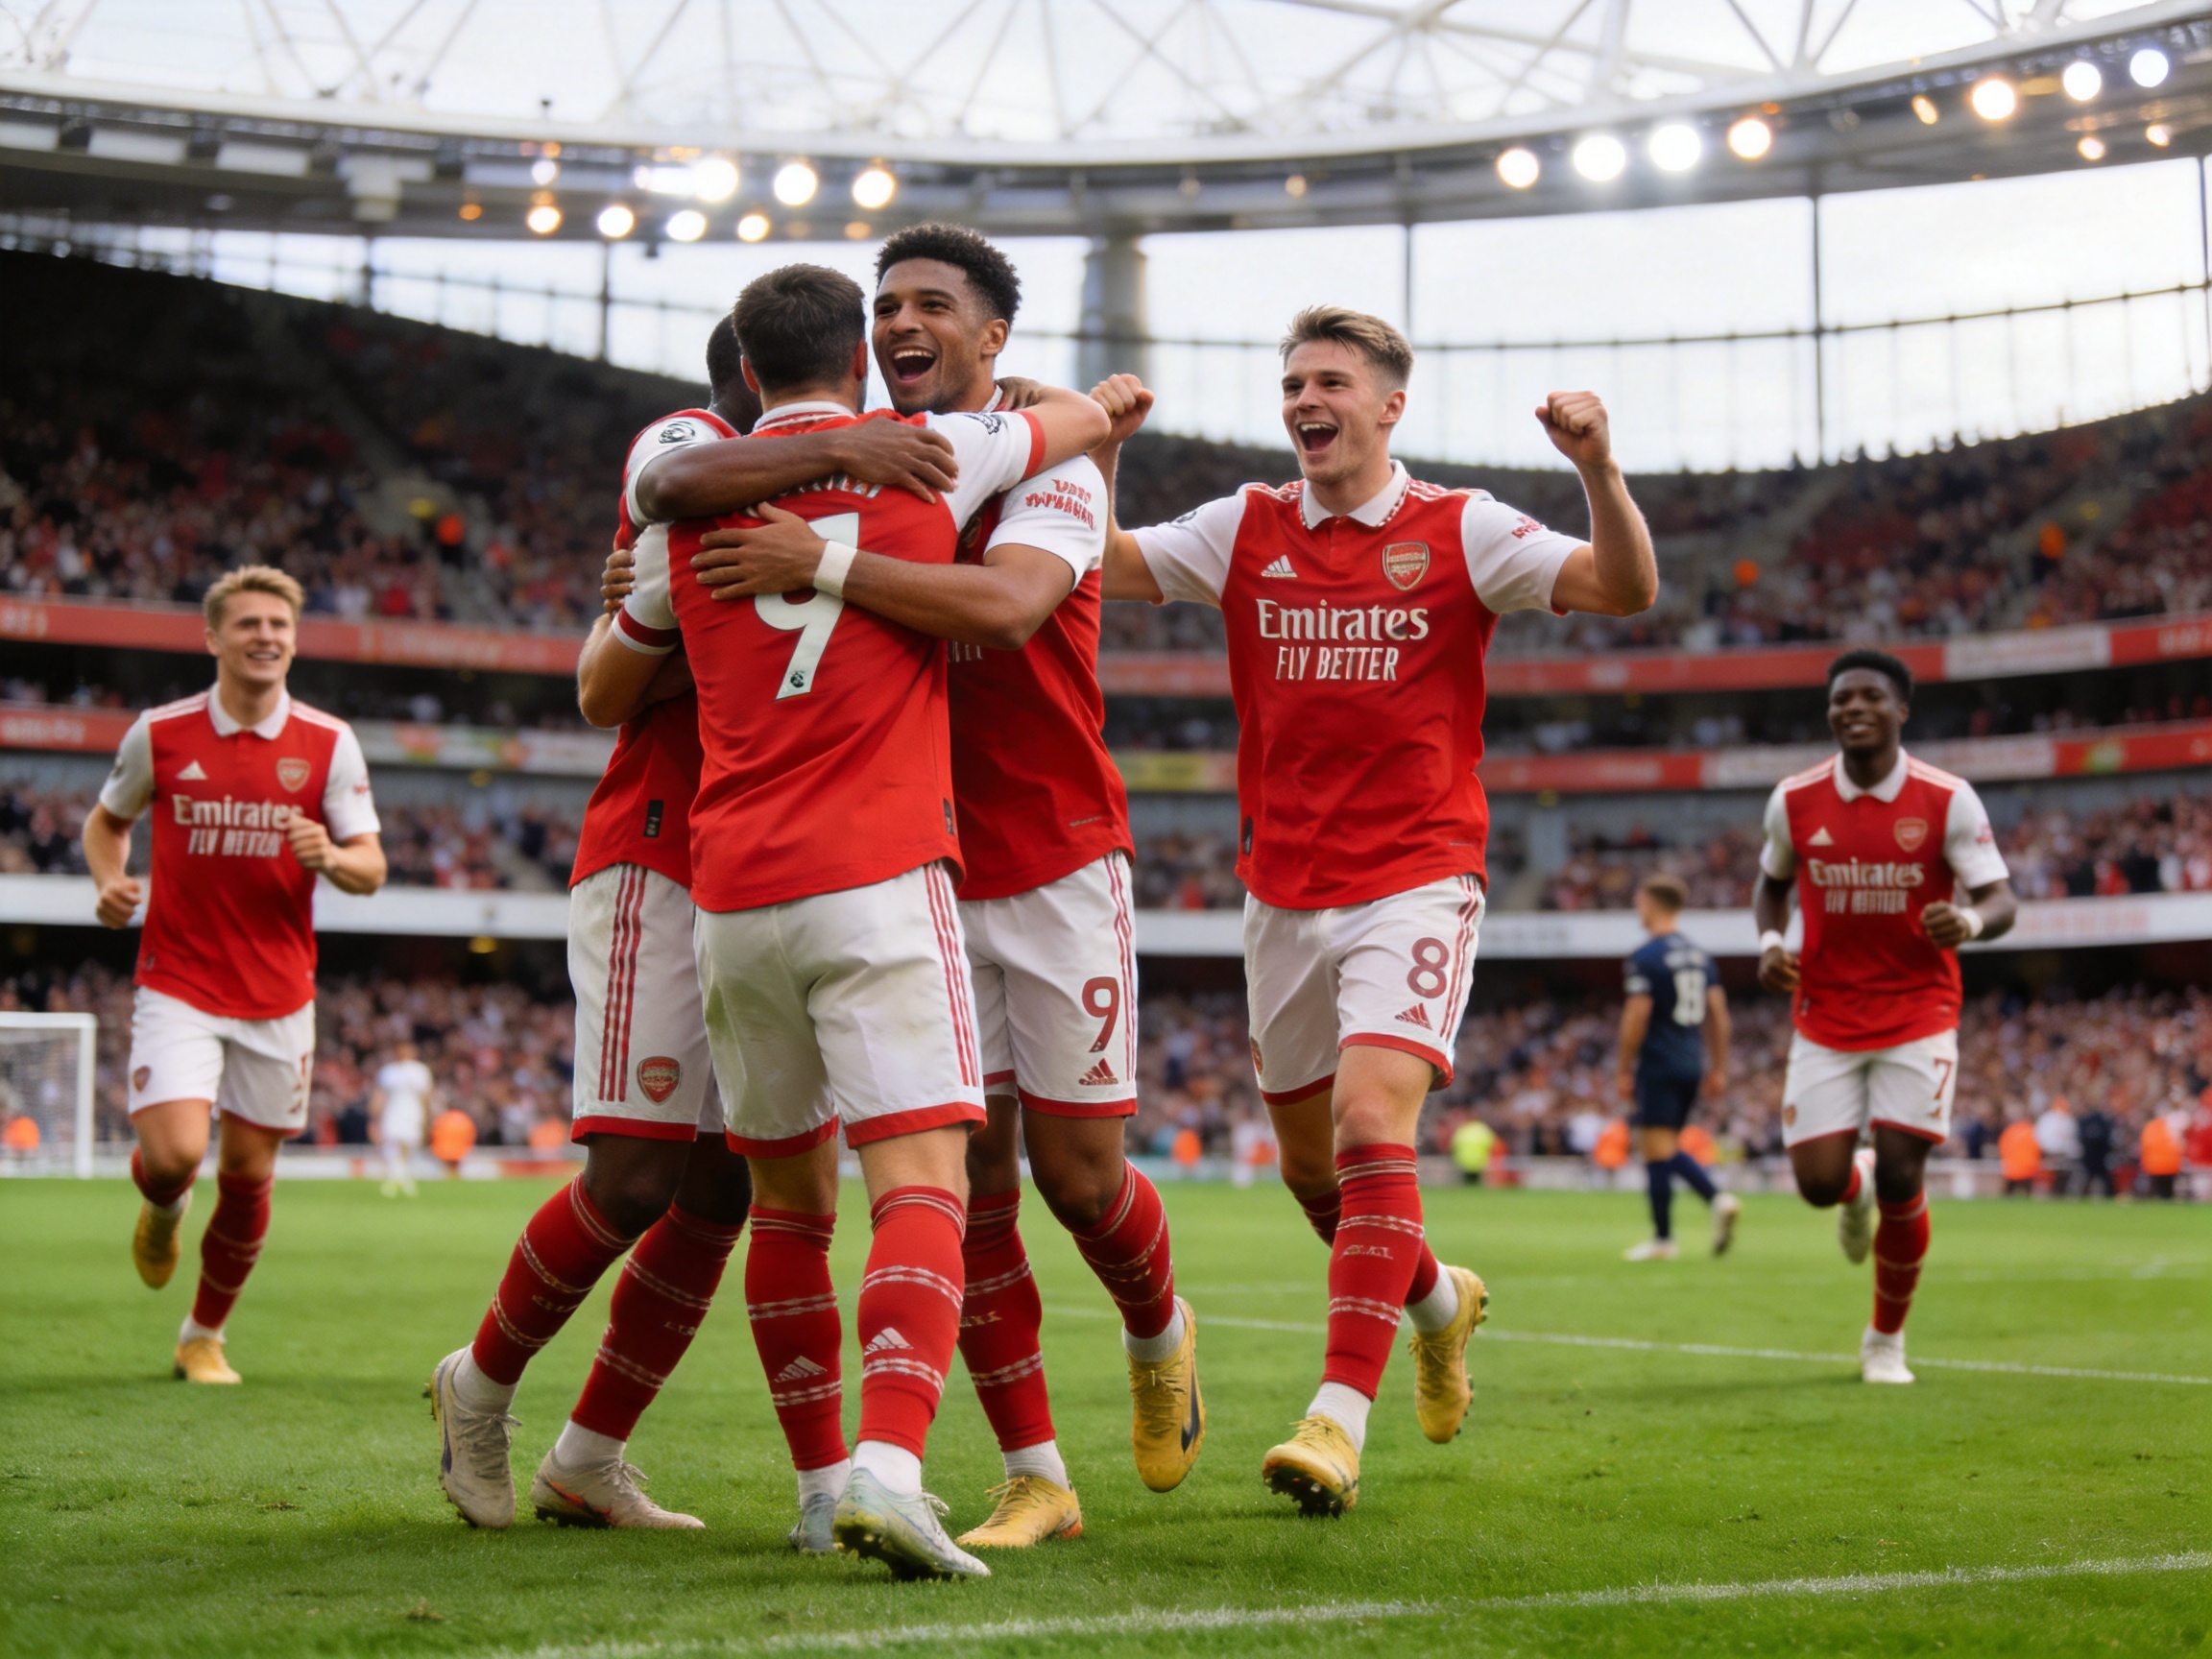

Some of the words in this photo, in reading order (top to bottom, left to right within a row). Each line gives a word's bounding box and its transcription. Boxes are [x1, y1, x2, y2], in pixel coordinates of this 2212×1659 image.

[1256, 598, 1429, 641] Emirates
[1275, 646, 1310, 681] FLY
[1315, 646, 1399, 681] BETTER
[1407, 937, 1449, 998] 8
[1082, 976, 1119, 1052] 9
[1934, 1058, 1953, 1101] 7
